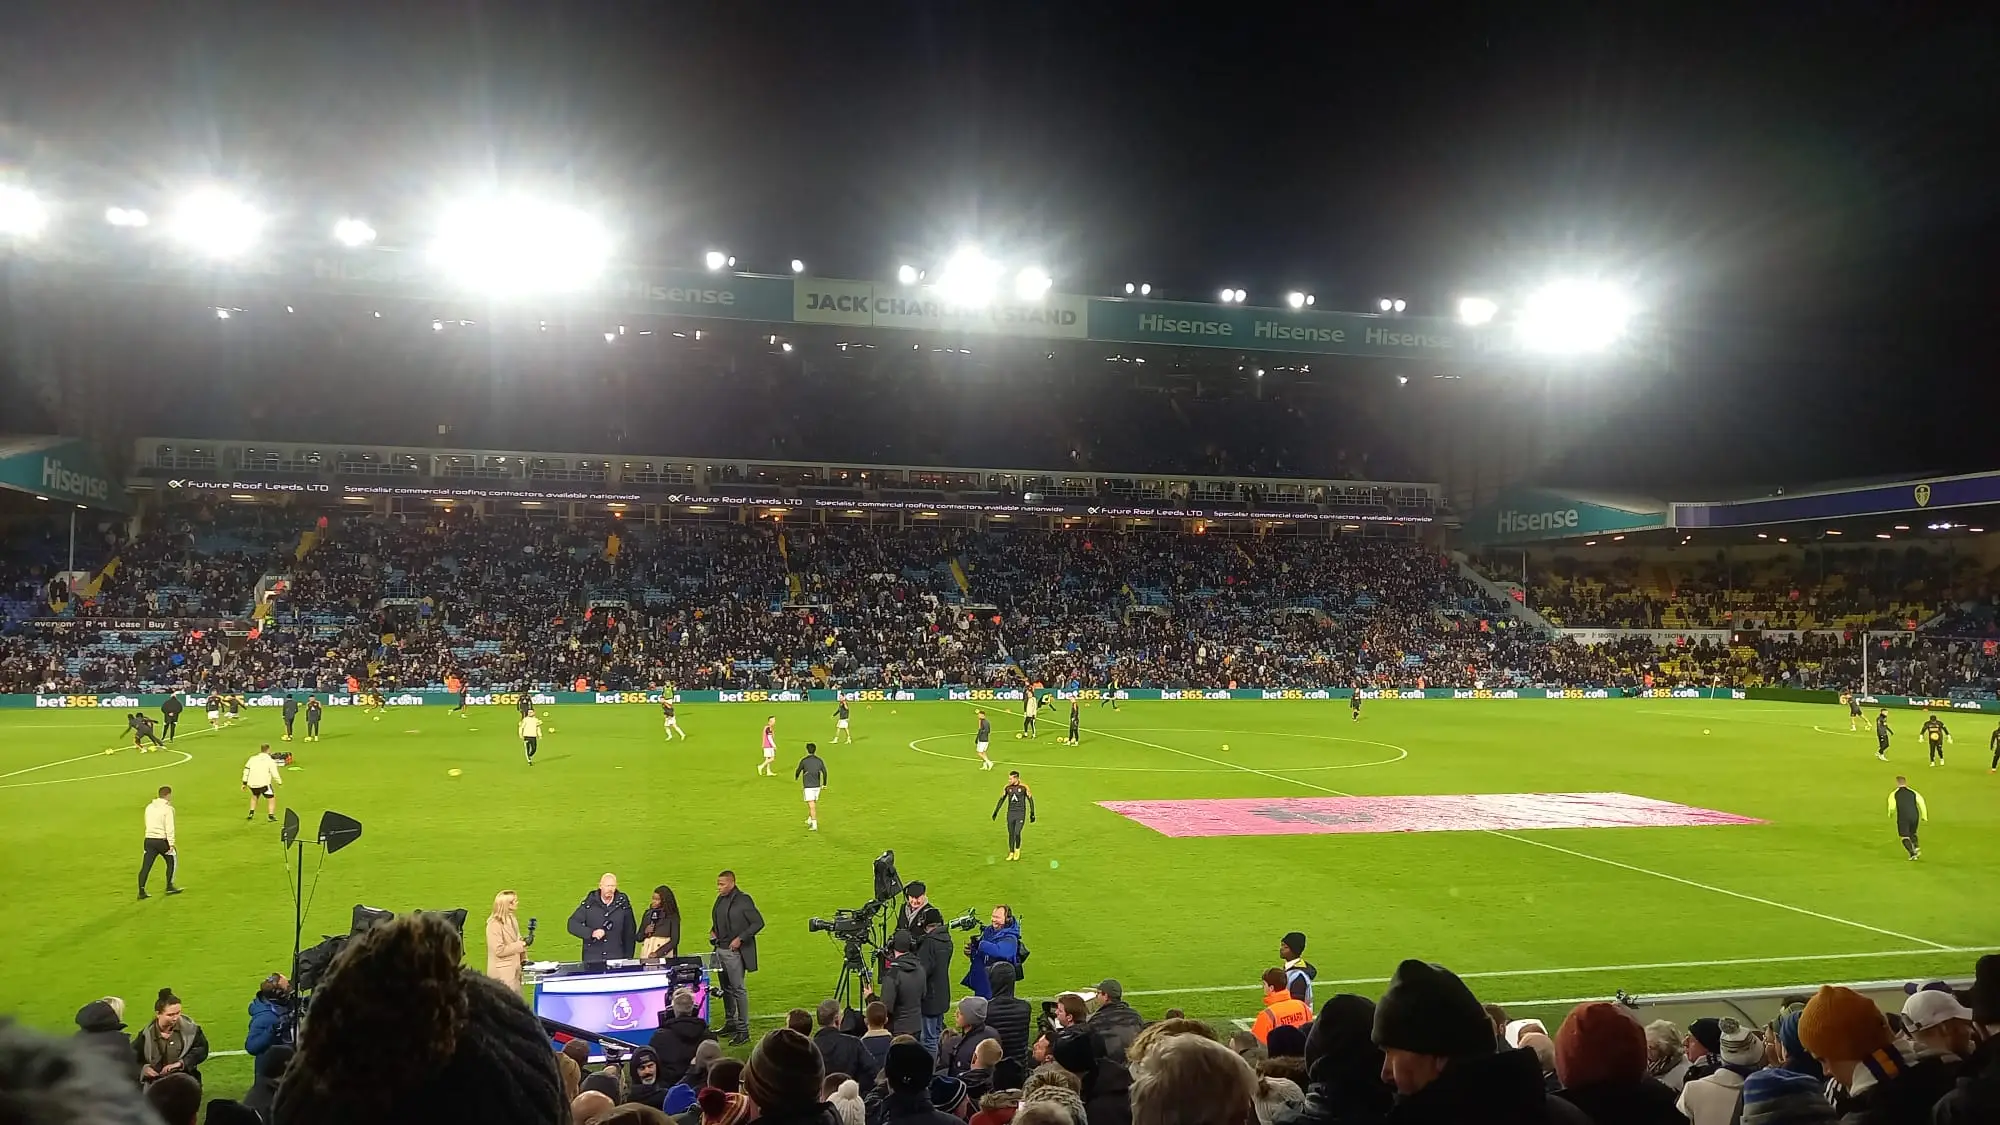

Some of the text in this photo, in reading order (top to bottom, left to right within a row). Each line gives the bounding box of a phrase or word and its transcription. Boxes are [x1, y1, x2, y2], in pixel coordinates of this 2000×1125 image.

[805, 292, 869, 313] JACK
[1002, 304, 1077, 326] STAND
[1138, 313, 1234, 337] Hisense
[1254, 320, 1346, 343] Hisense
[1364, 326, 1454, 350] Hisense
[42, 456, 109, 501] Hisense
[187, 480, 229, 488] Future
[232, 481, 262, 489] Roof
[265, 482, 303, 490] Leeds
[344, 485, 392, 493] Specialist
[451, 488, 487, 497] roofing
[488, 490, 544, 498] contractors
[684, 495, 719, 503] Future
[721, 496, 746, 504] Roof
[815, 499, 855, 507] Specialist
[905, 502, 935, 511] roofing
[1101, 507, 1131, 515] Future
[1213, 510, 1248, 518] Specialist
[1496, 508, 1579, 534] Hisense
[114, 619, 141, 629] Lease
[148, 619, 166, 631] Buy
[595, 692, 681, 704] bet365.cm
[719, 691, 800, 703] bet365.com
[949, 689, 1023, 700] bet365.com
[1161, 689, 1231, 700] bet365.com
[1262, 689, 1330, 700] bet365.com
[1359, 688, 1425, 699] bet365.com
[1454, 689, 1518, 699] bet365.com
[1546, 688, 1608, 699] bet365.com
[1642, 688, 1700, 699] et365.com
[36, 695, 139, 708] bet365.com
[328, 694, 423, 706] bet36.com
[1280, 1011, 1304, 1025] STEWARD
